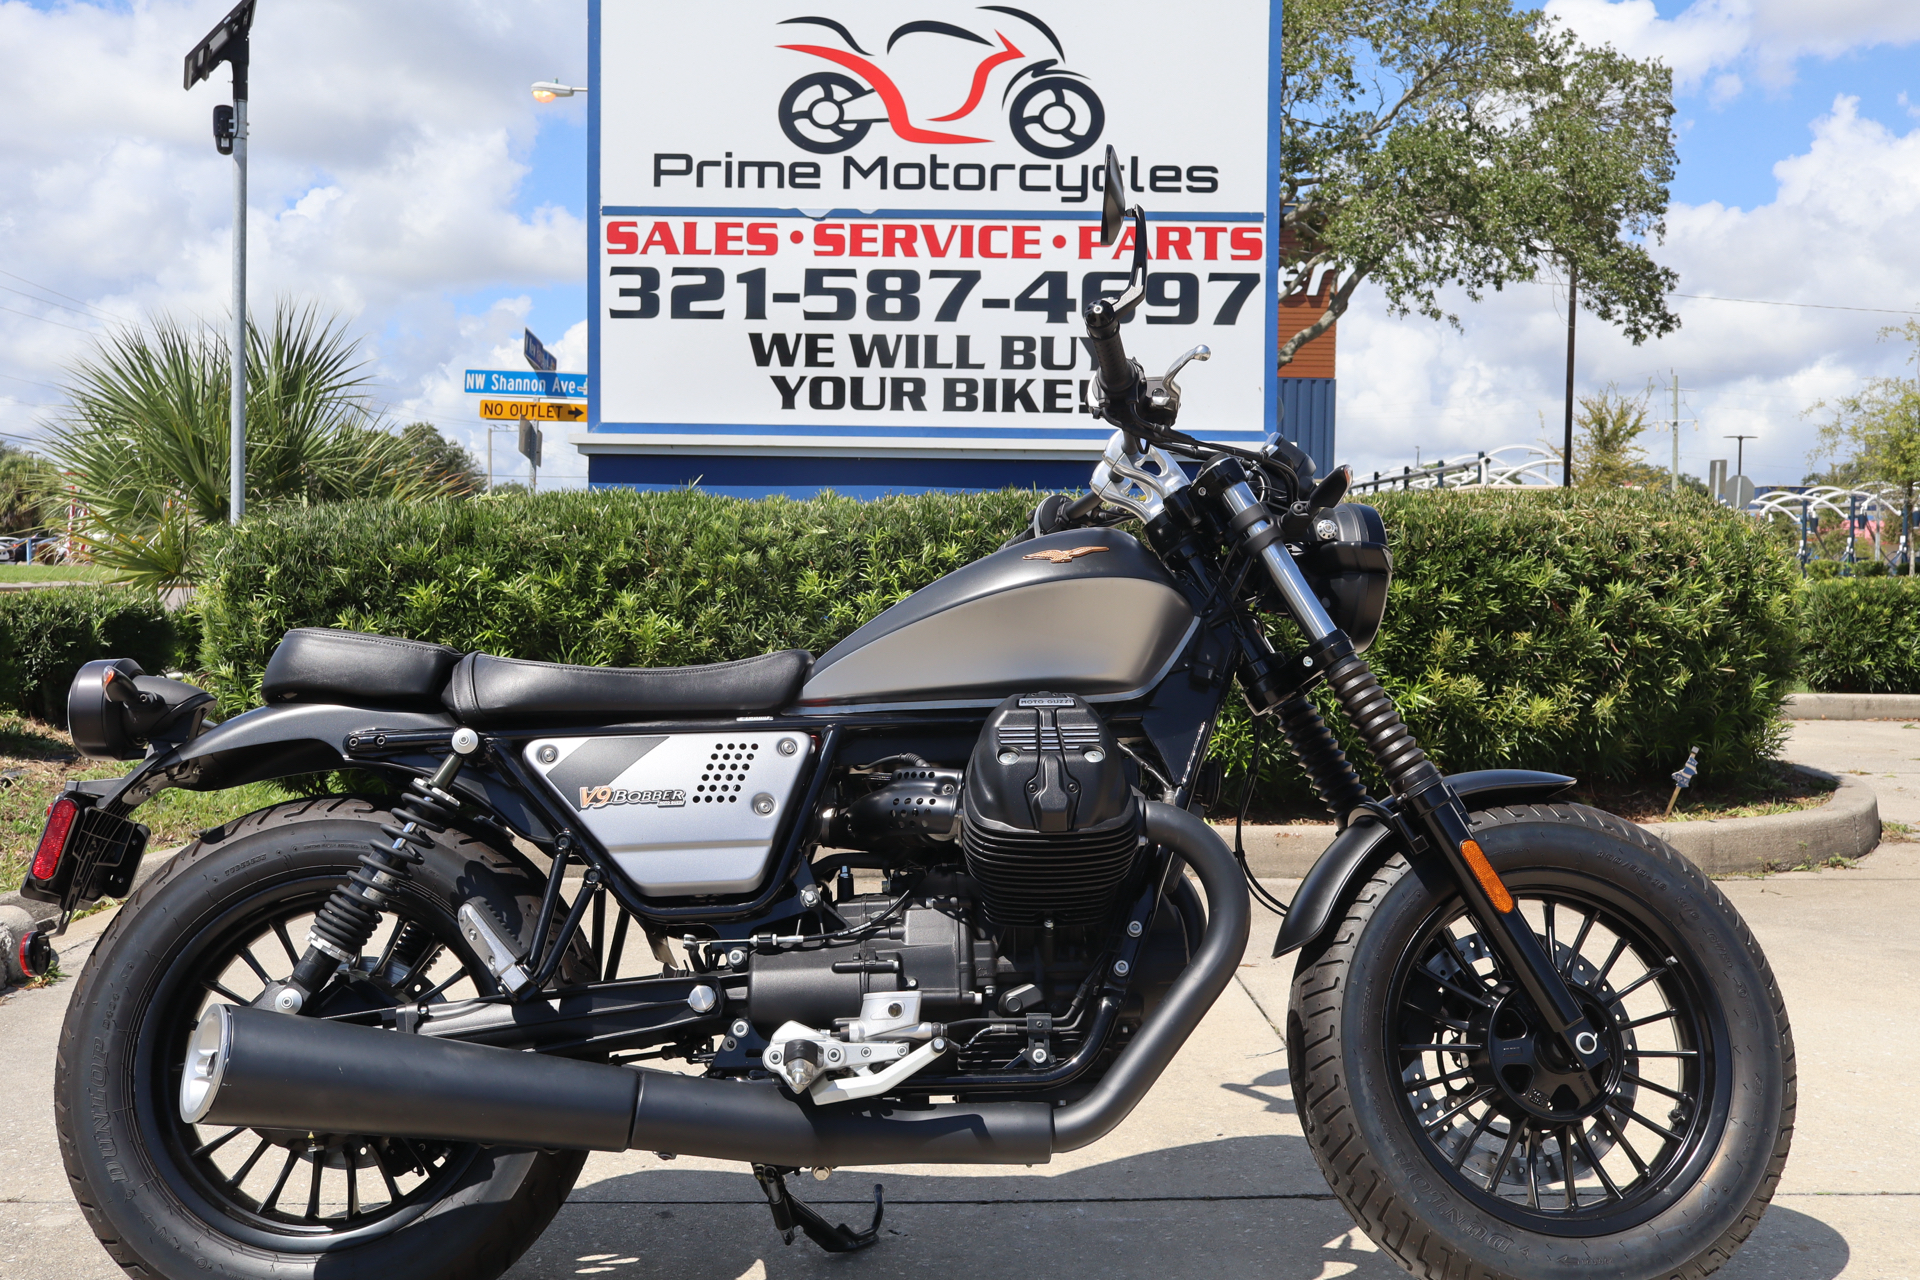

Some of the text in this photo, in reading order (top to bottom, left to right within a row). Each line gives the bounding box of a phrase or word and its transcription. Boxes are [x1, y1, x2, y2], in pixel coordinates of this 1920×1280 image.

[653, 151, 821, 189] Prime
[606, 221, 1263, 261] SALES SERVICE PARTS
[608, 266, 1261, 326] 321-587-4697
[748, 332, 835, 368] WE
[848, 334, 985, 370] WILL
[466, 373, 576, 393] NW Shannon Ave
[769, 375, 928, 411] YOUR
[484, 403, 563, 418] NO OUTLET
[580, 785, 684, 808] V9 BOBBER
